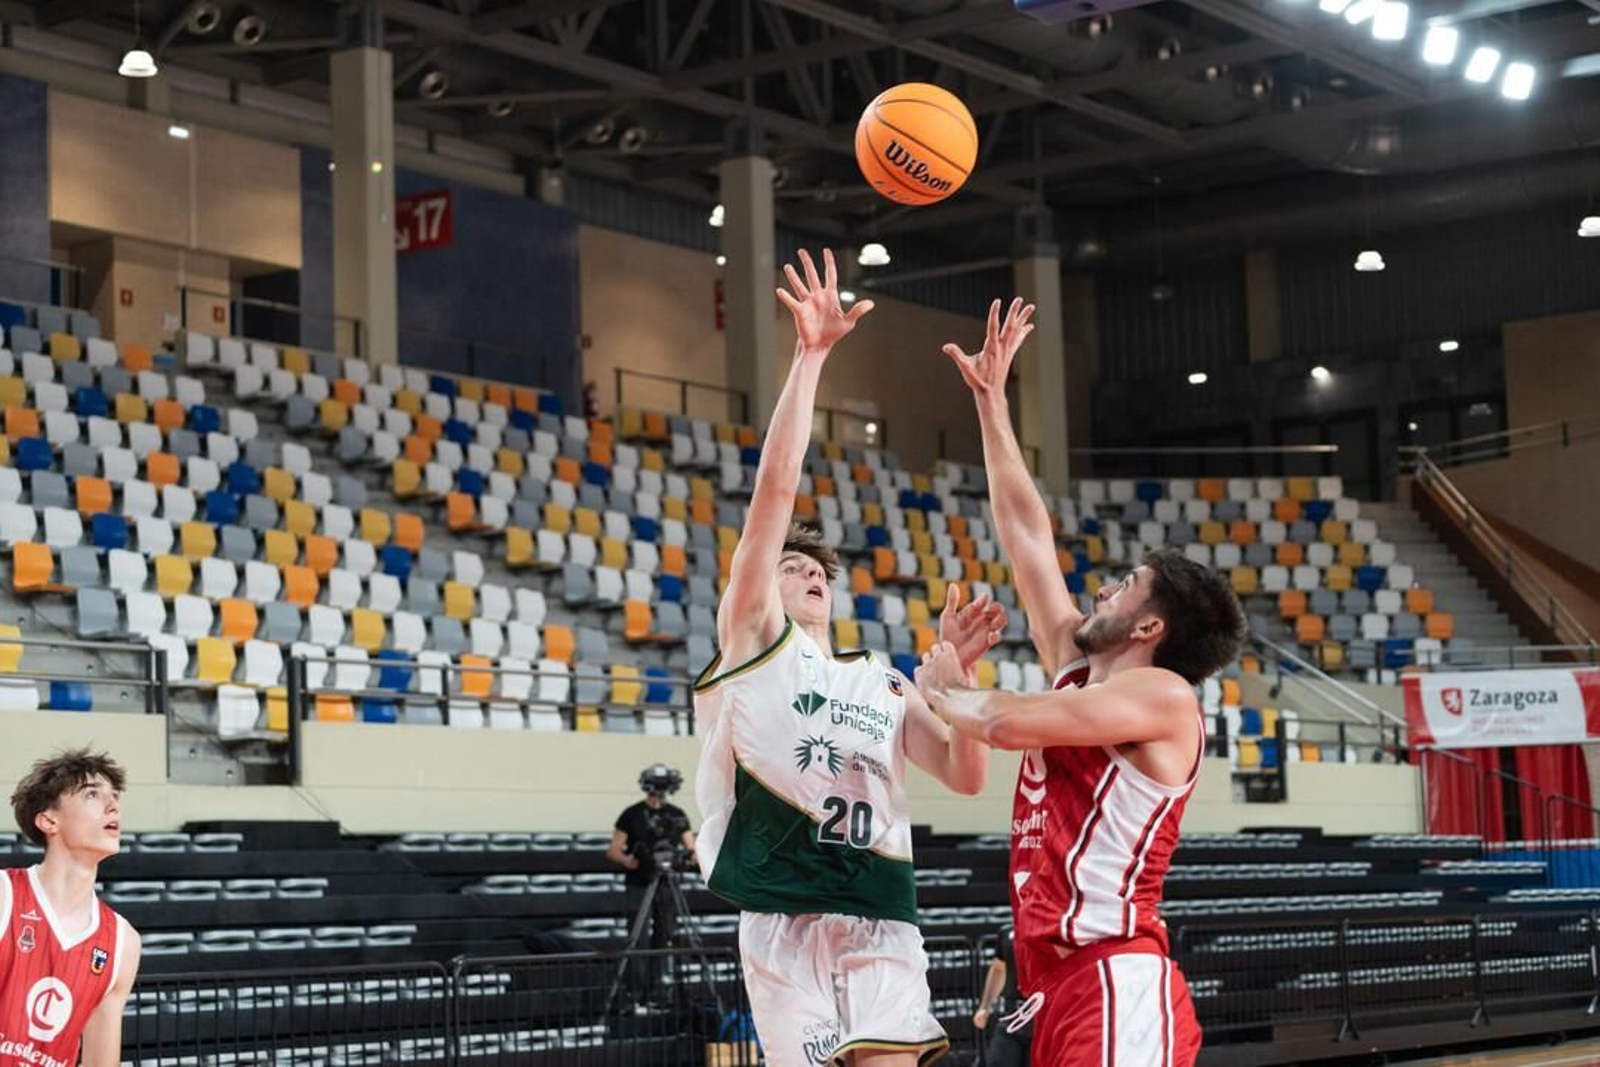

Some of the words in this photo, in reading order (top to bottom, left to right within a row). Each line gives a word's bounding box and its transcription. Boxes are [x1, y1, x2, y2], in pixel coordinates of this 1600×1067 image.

[885, 140, 952, 192] Wilson
[414, 197, 448, 242] 17
[1469, 688, 1559, 711] Zaragoza
[830, 712, 886, 740] Unicaja
[818, 795, 873, 849] 20
